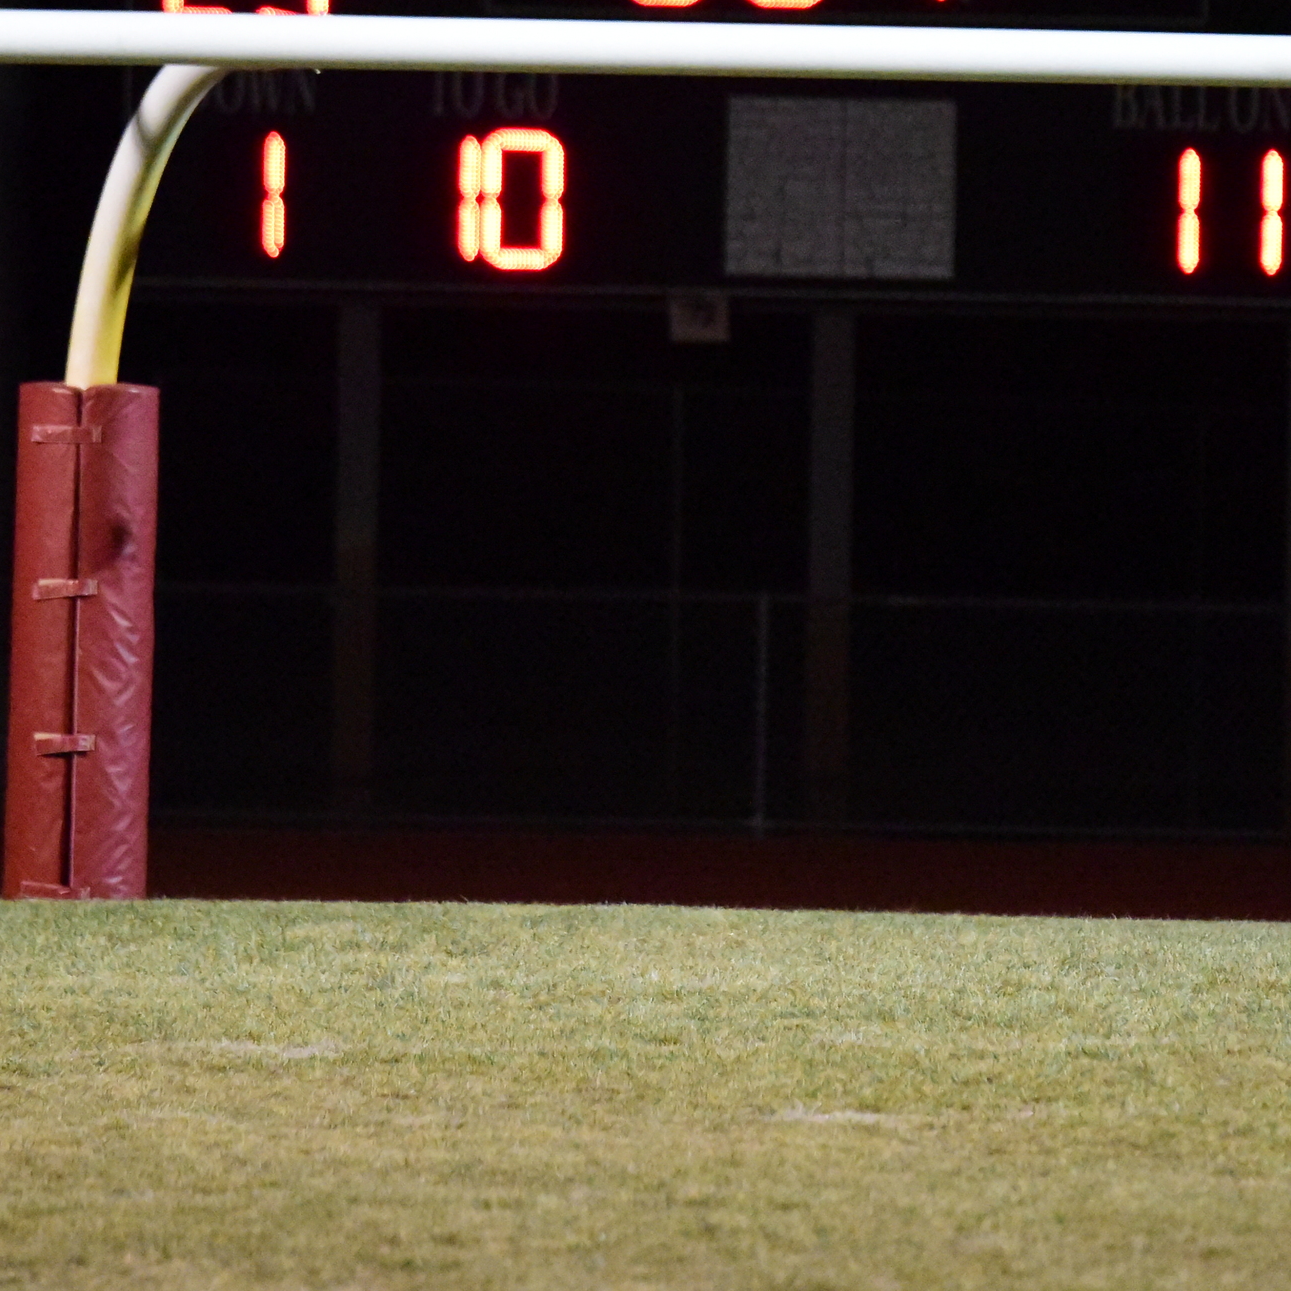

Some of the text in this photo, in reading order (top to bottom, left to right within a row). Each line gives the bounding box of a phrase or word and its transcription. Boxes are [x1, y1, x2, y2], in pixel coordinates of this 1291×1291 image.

[204, 69, 317, 114] OWN
[1112, 85, 1291, 134] BALL ON
[259, 130, 287, 258] 1
[454, 126, 567, 273] 10
